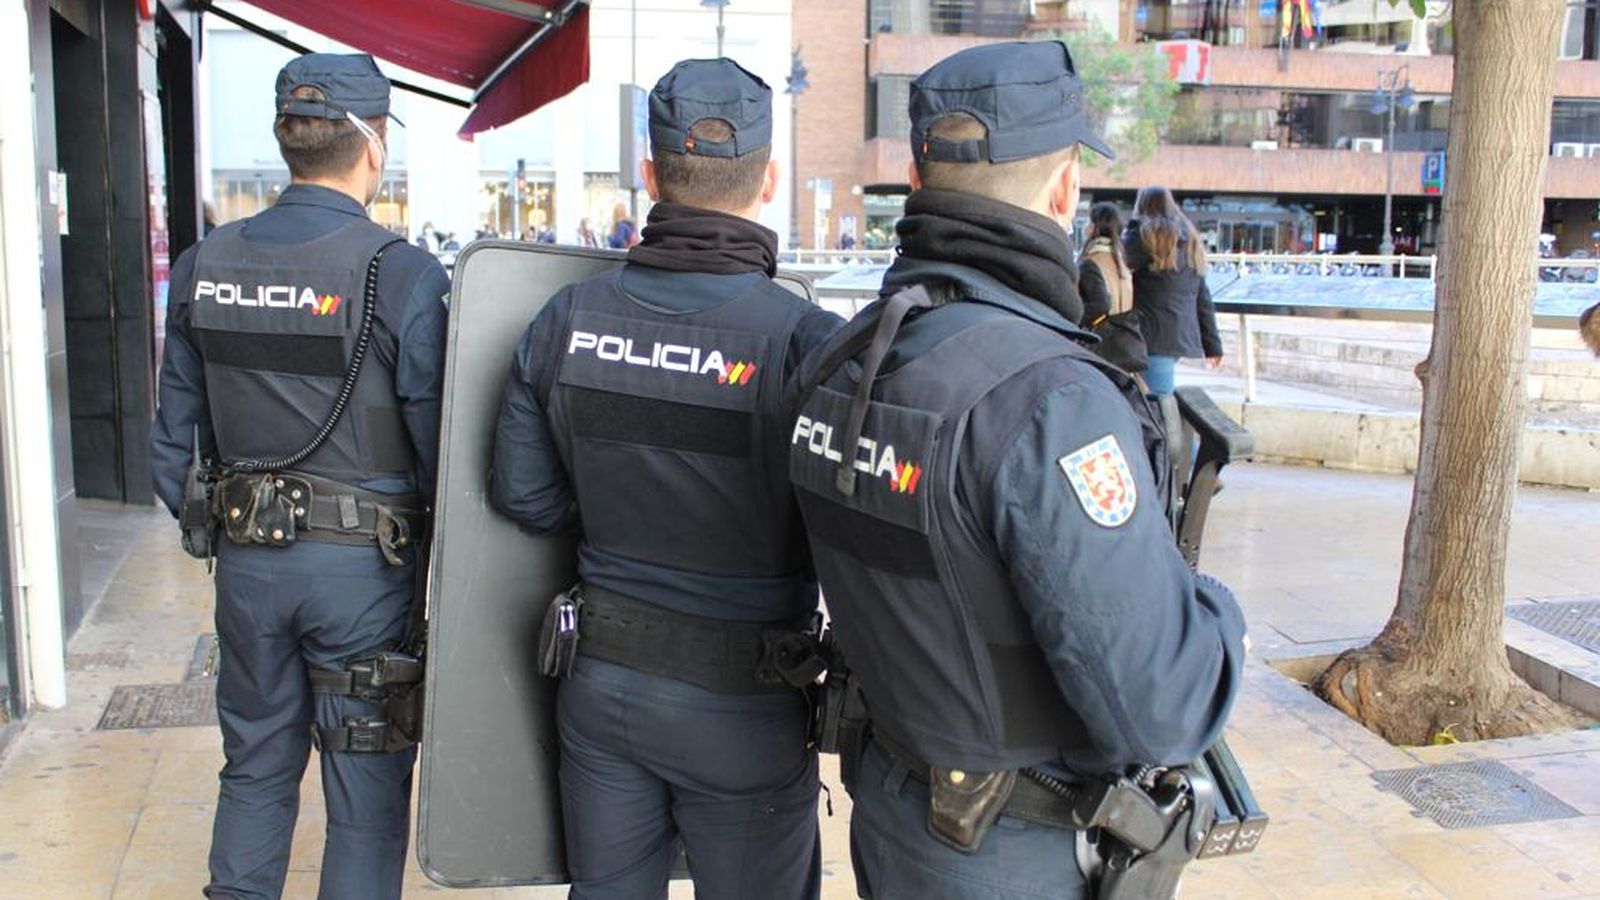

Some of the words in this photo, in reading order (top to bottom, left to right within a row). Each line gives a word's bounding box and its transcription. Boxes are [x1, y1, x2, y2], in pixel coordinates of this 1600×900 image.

[1428, 156, 1438, 179] P
[195, 280, 320, 309] POLICIA
[568, 330, 727, 376] POLICIA
[791, 414, 899, 481] POLCIA
